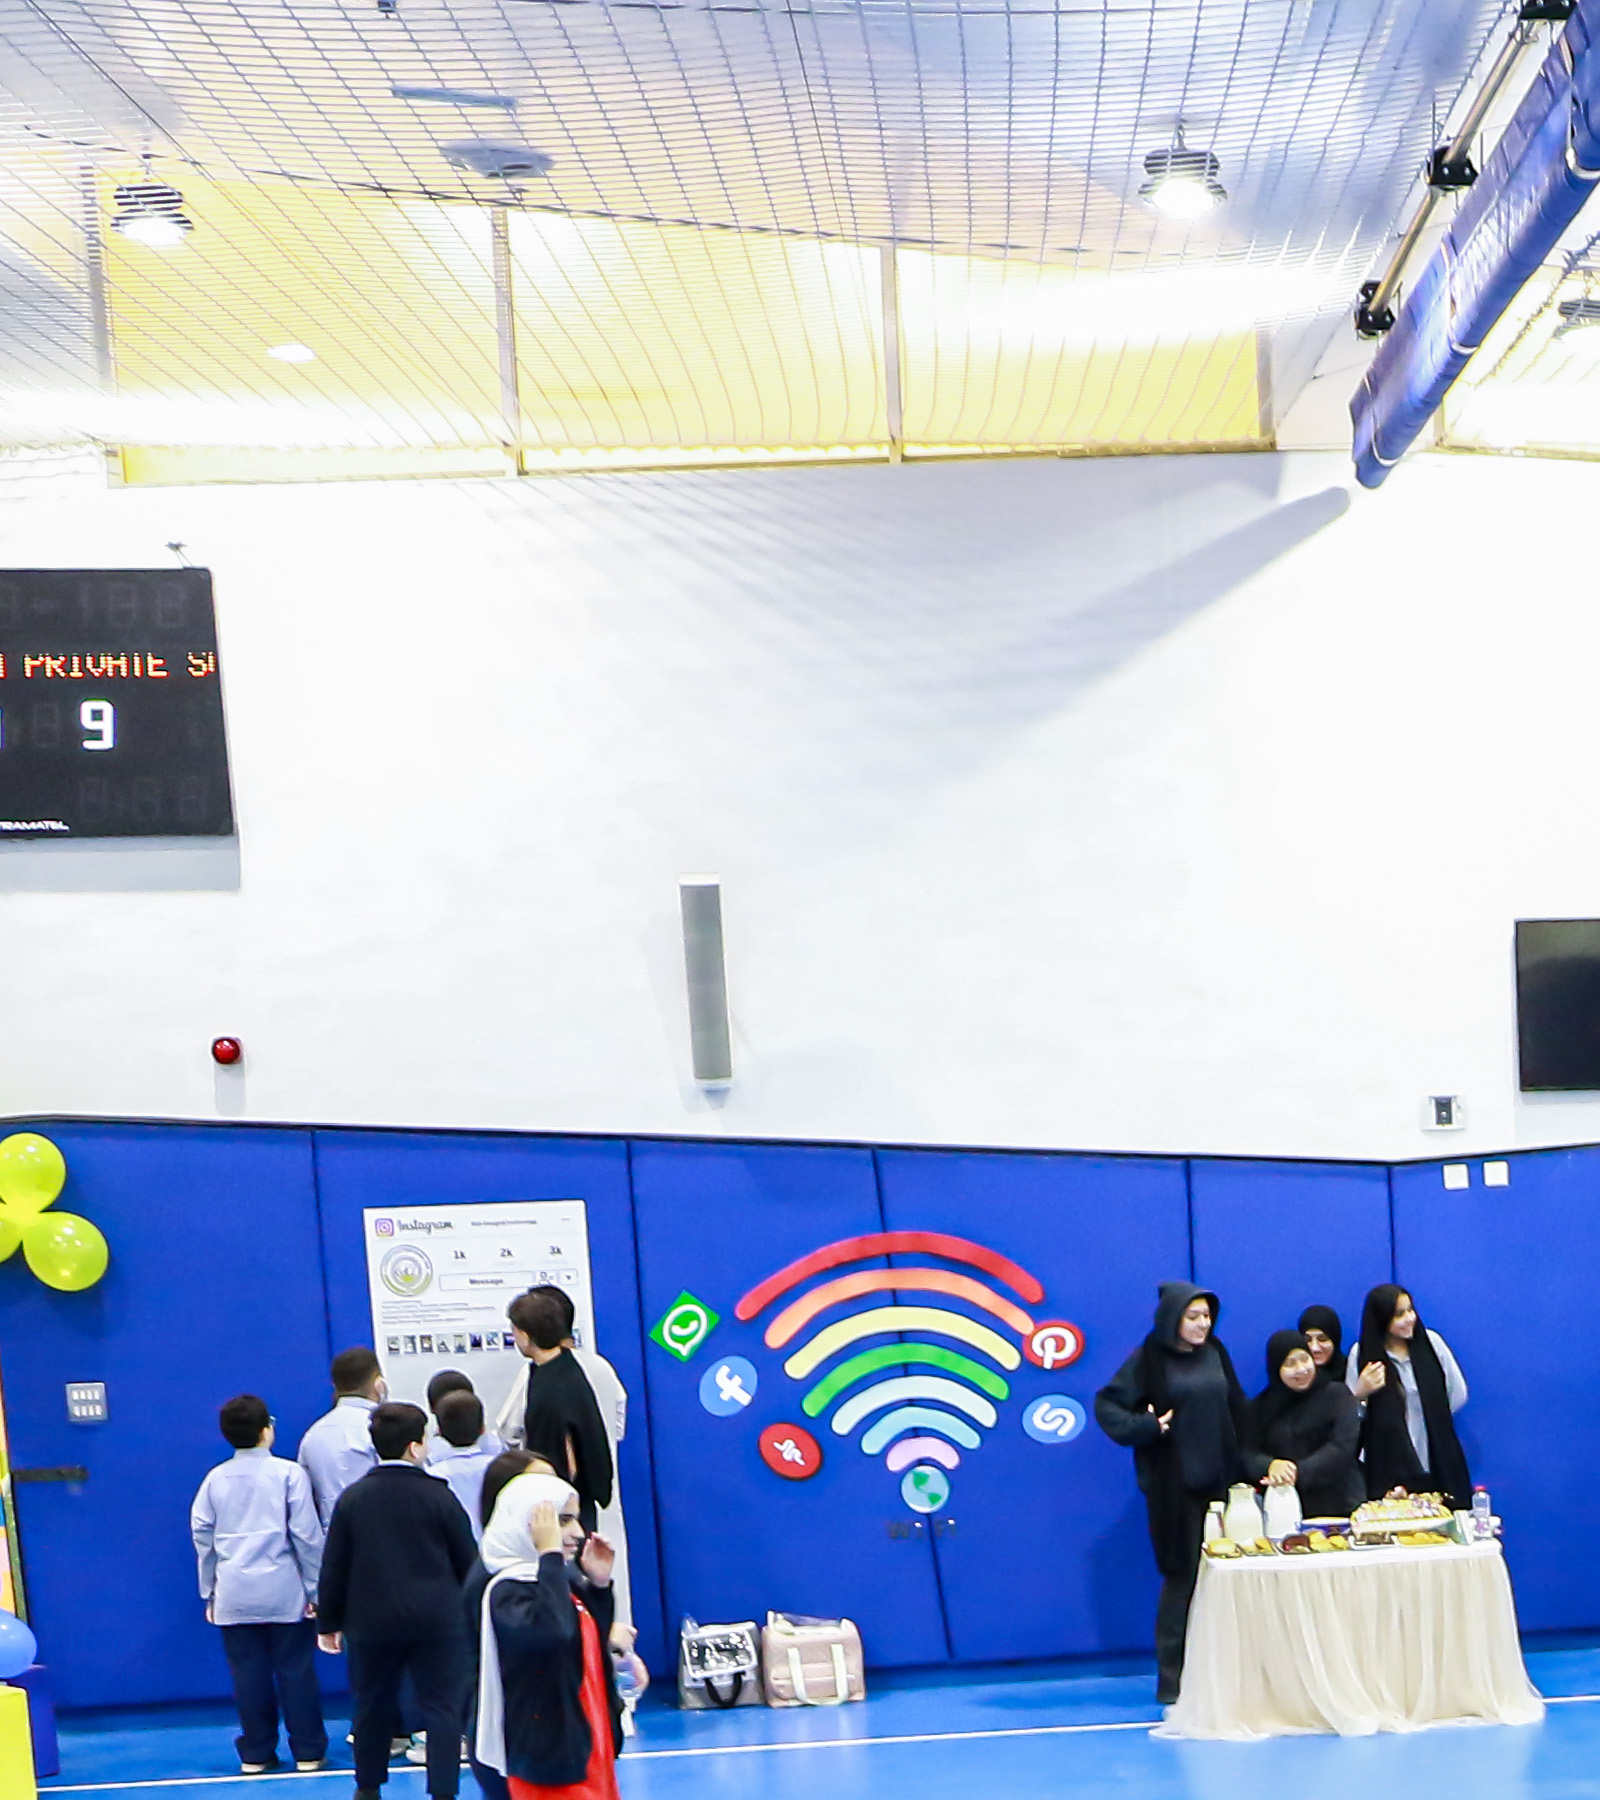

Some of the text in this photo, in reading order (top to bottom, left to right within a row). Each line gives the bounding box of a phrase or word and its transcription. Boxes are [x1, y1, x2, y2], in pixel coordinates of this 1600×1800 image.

[23, 652, 169, 678] PRIVATE
[79, 697, 116, 751] 9
[0, 818, 70, 832] RAMATEL
[397, 1217, 453, 1234] Instagram
